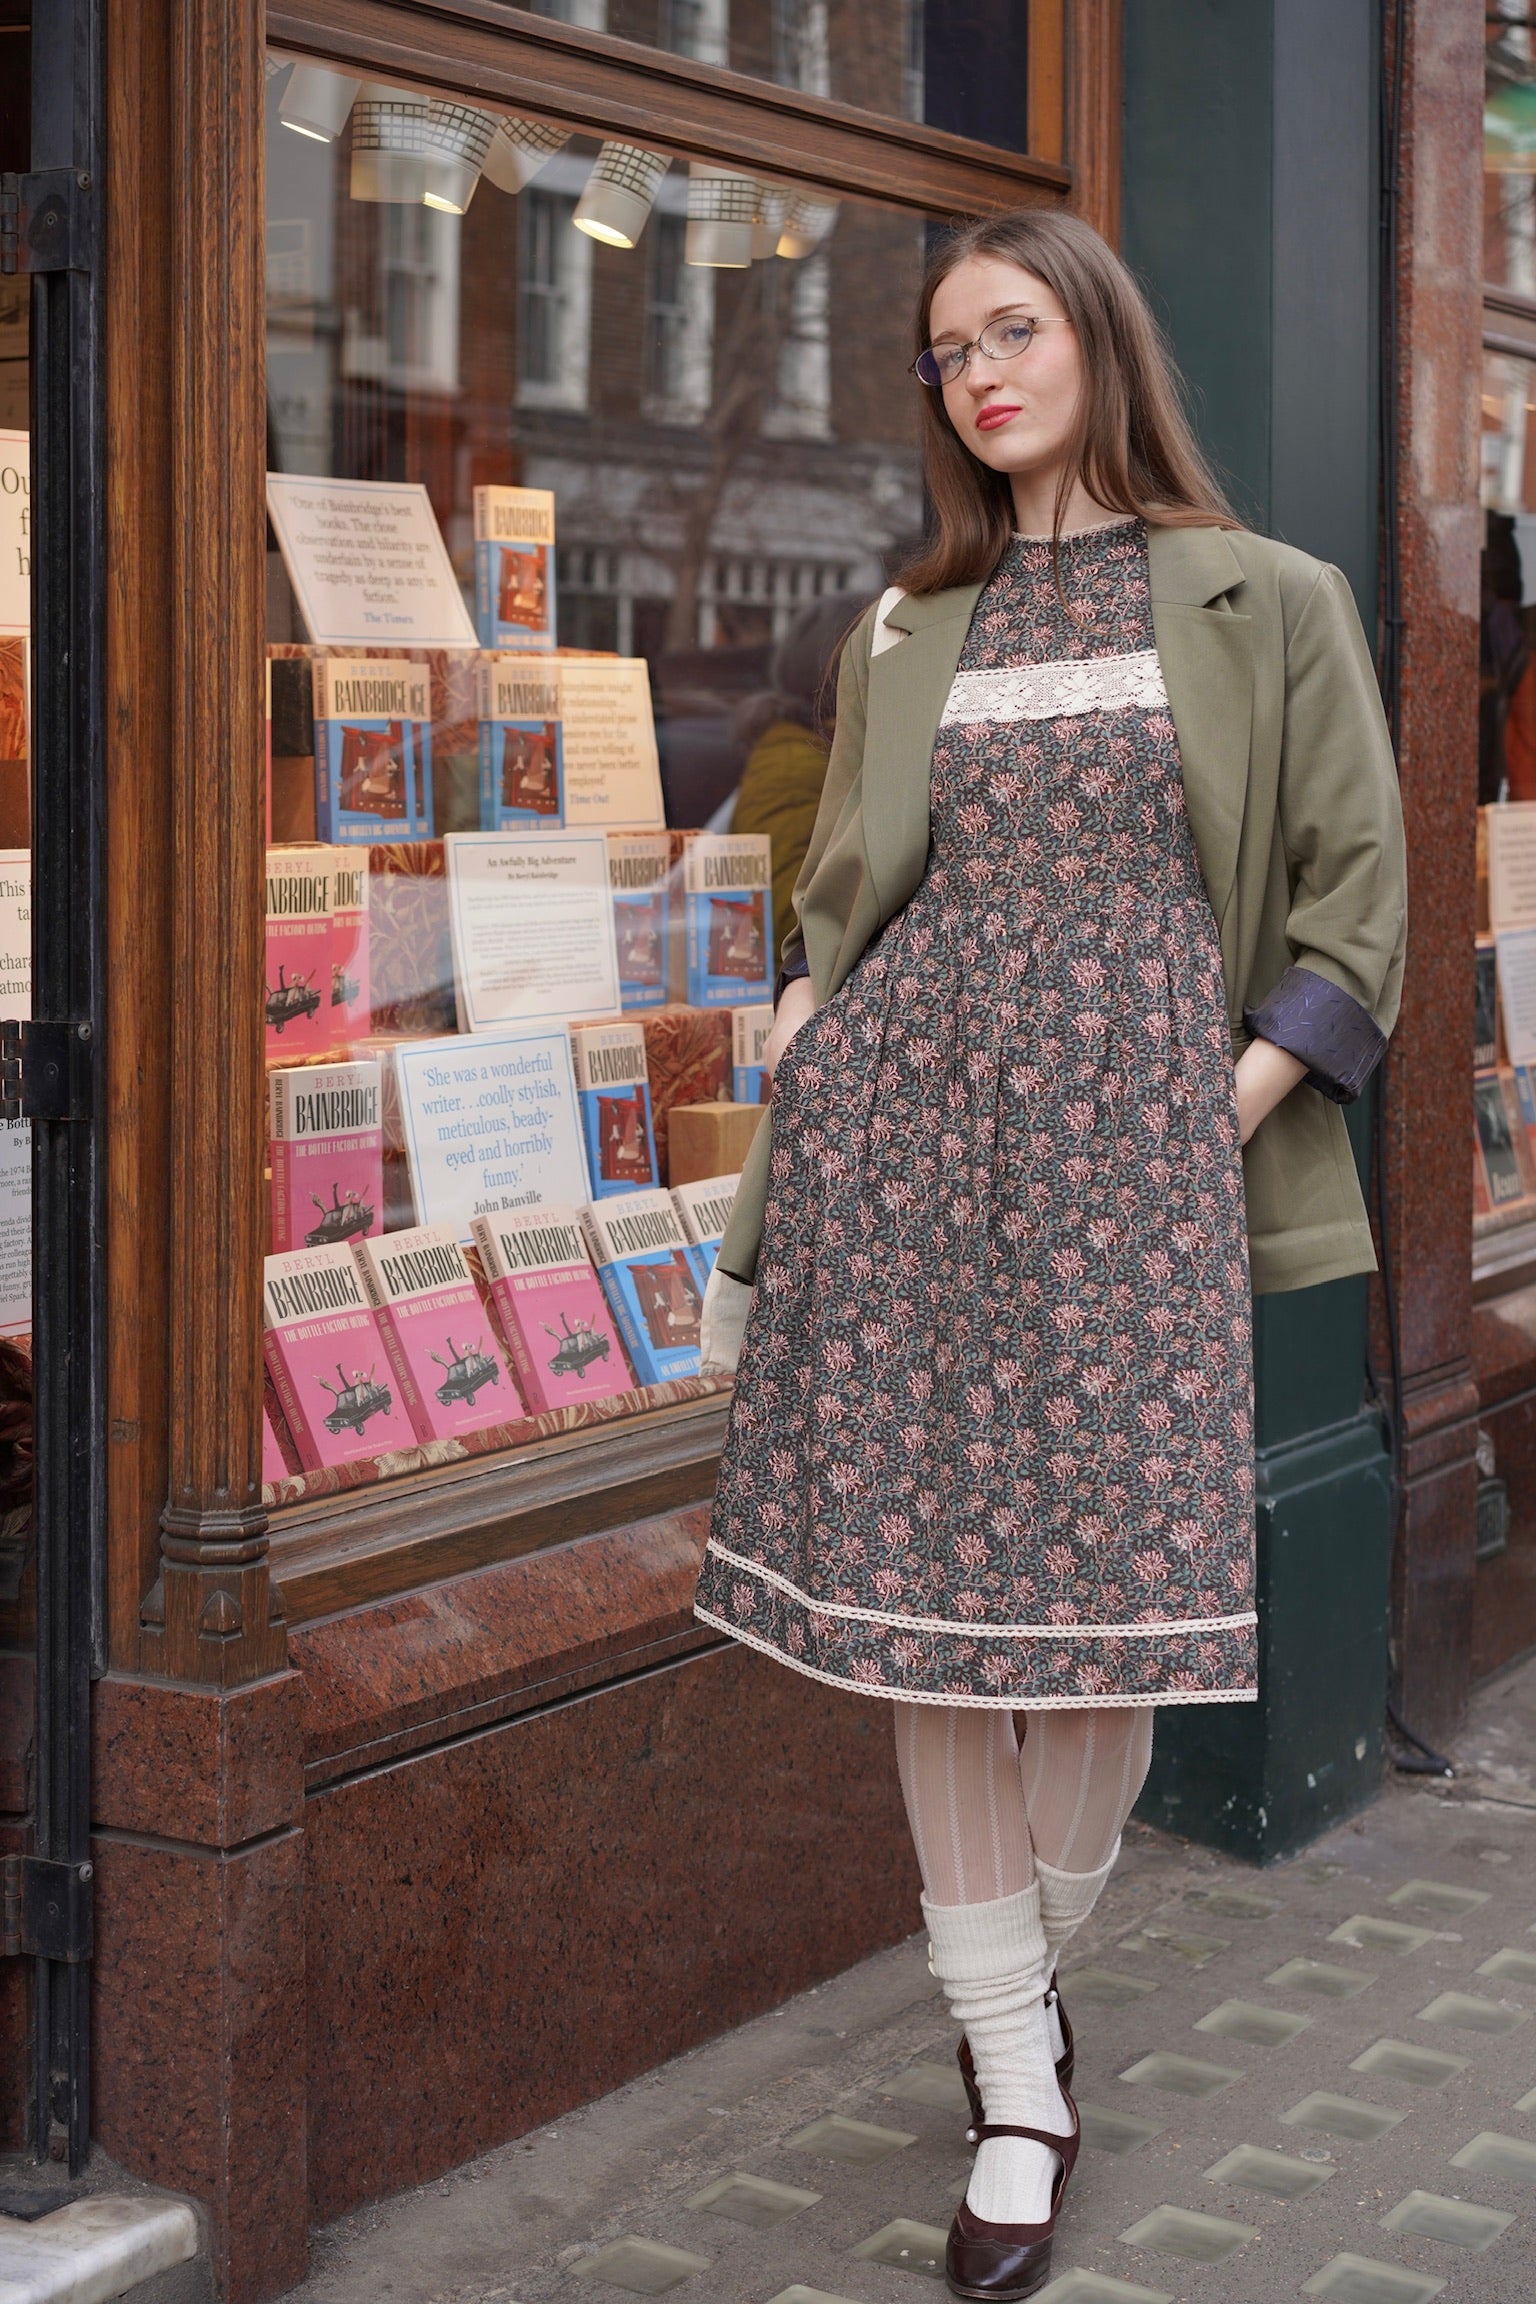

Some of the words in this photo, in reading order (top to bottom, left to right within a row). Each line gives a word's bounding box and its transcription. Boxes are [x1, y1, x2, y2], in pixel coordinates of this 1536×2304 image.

[334, 680, 407, 713] BAINBRIDGE
[704, 854, 769, 887] BAINBRIDGE
[266, 875, 329, 914] NBRIDGE
[315, 1073, 363, 1089] BERYL
[453, 1068, 478, 1084] was
[480, 1068, 488, 1080] a
[490, 1052, 553, 1079] wonderful
[588, 1045, 645, 1084] BAINBRIDGE
[518, 1078, 561, 1104] stylish,
[296, 1086, 378, 1134] BAINBRIDGE
[438, 1115, 510, 1141] meticulous,
[511, 1106, 553, 1129] beady-
[446, 1144, 476, 1171] eyed
[478, 1140, 500, 1161] and
[503, 1132, 553, 1155] horribly
[473, 1199, 500, 1215] John
[501, 1190, 542, 1210] Banville
[704, 1183, 734, 1197] BERY
[513, 1213, 560, 1228] BERYL
[605, 1209, 683, 1254] BAINBRIDGE
[393, 1232, 441, 1251] BERYL
[500, 1225, 585, 1269] BAINBRIDGE
[282, 1254, 334, 1273] BERYL
[380, 1243, 469, 1296] BAINBRIDGE
[267, 1265, 364, 1319] BAINBRIDGE
[396, 1305, 410, 1318] THE
[283, 1329, 298, 1343] THE
[297, 1323, 322, 1340] BOTTLE
